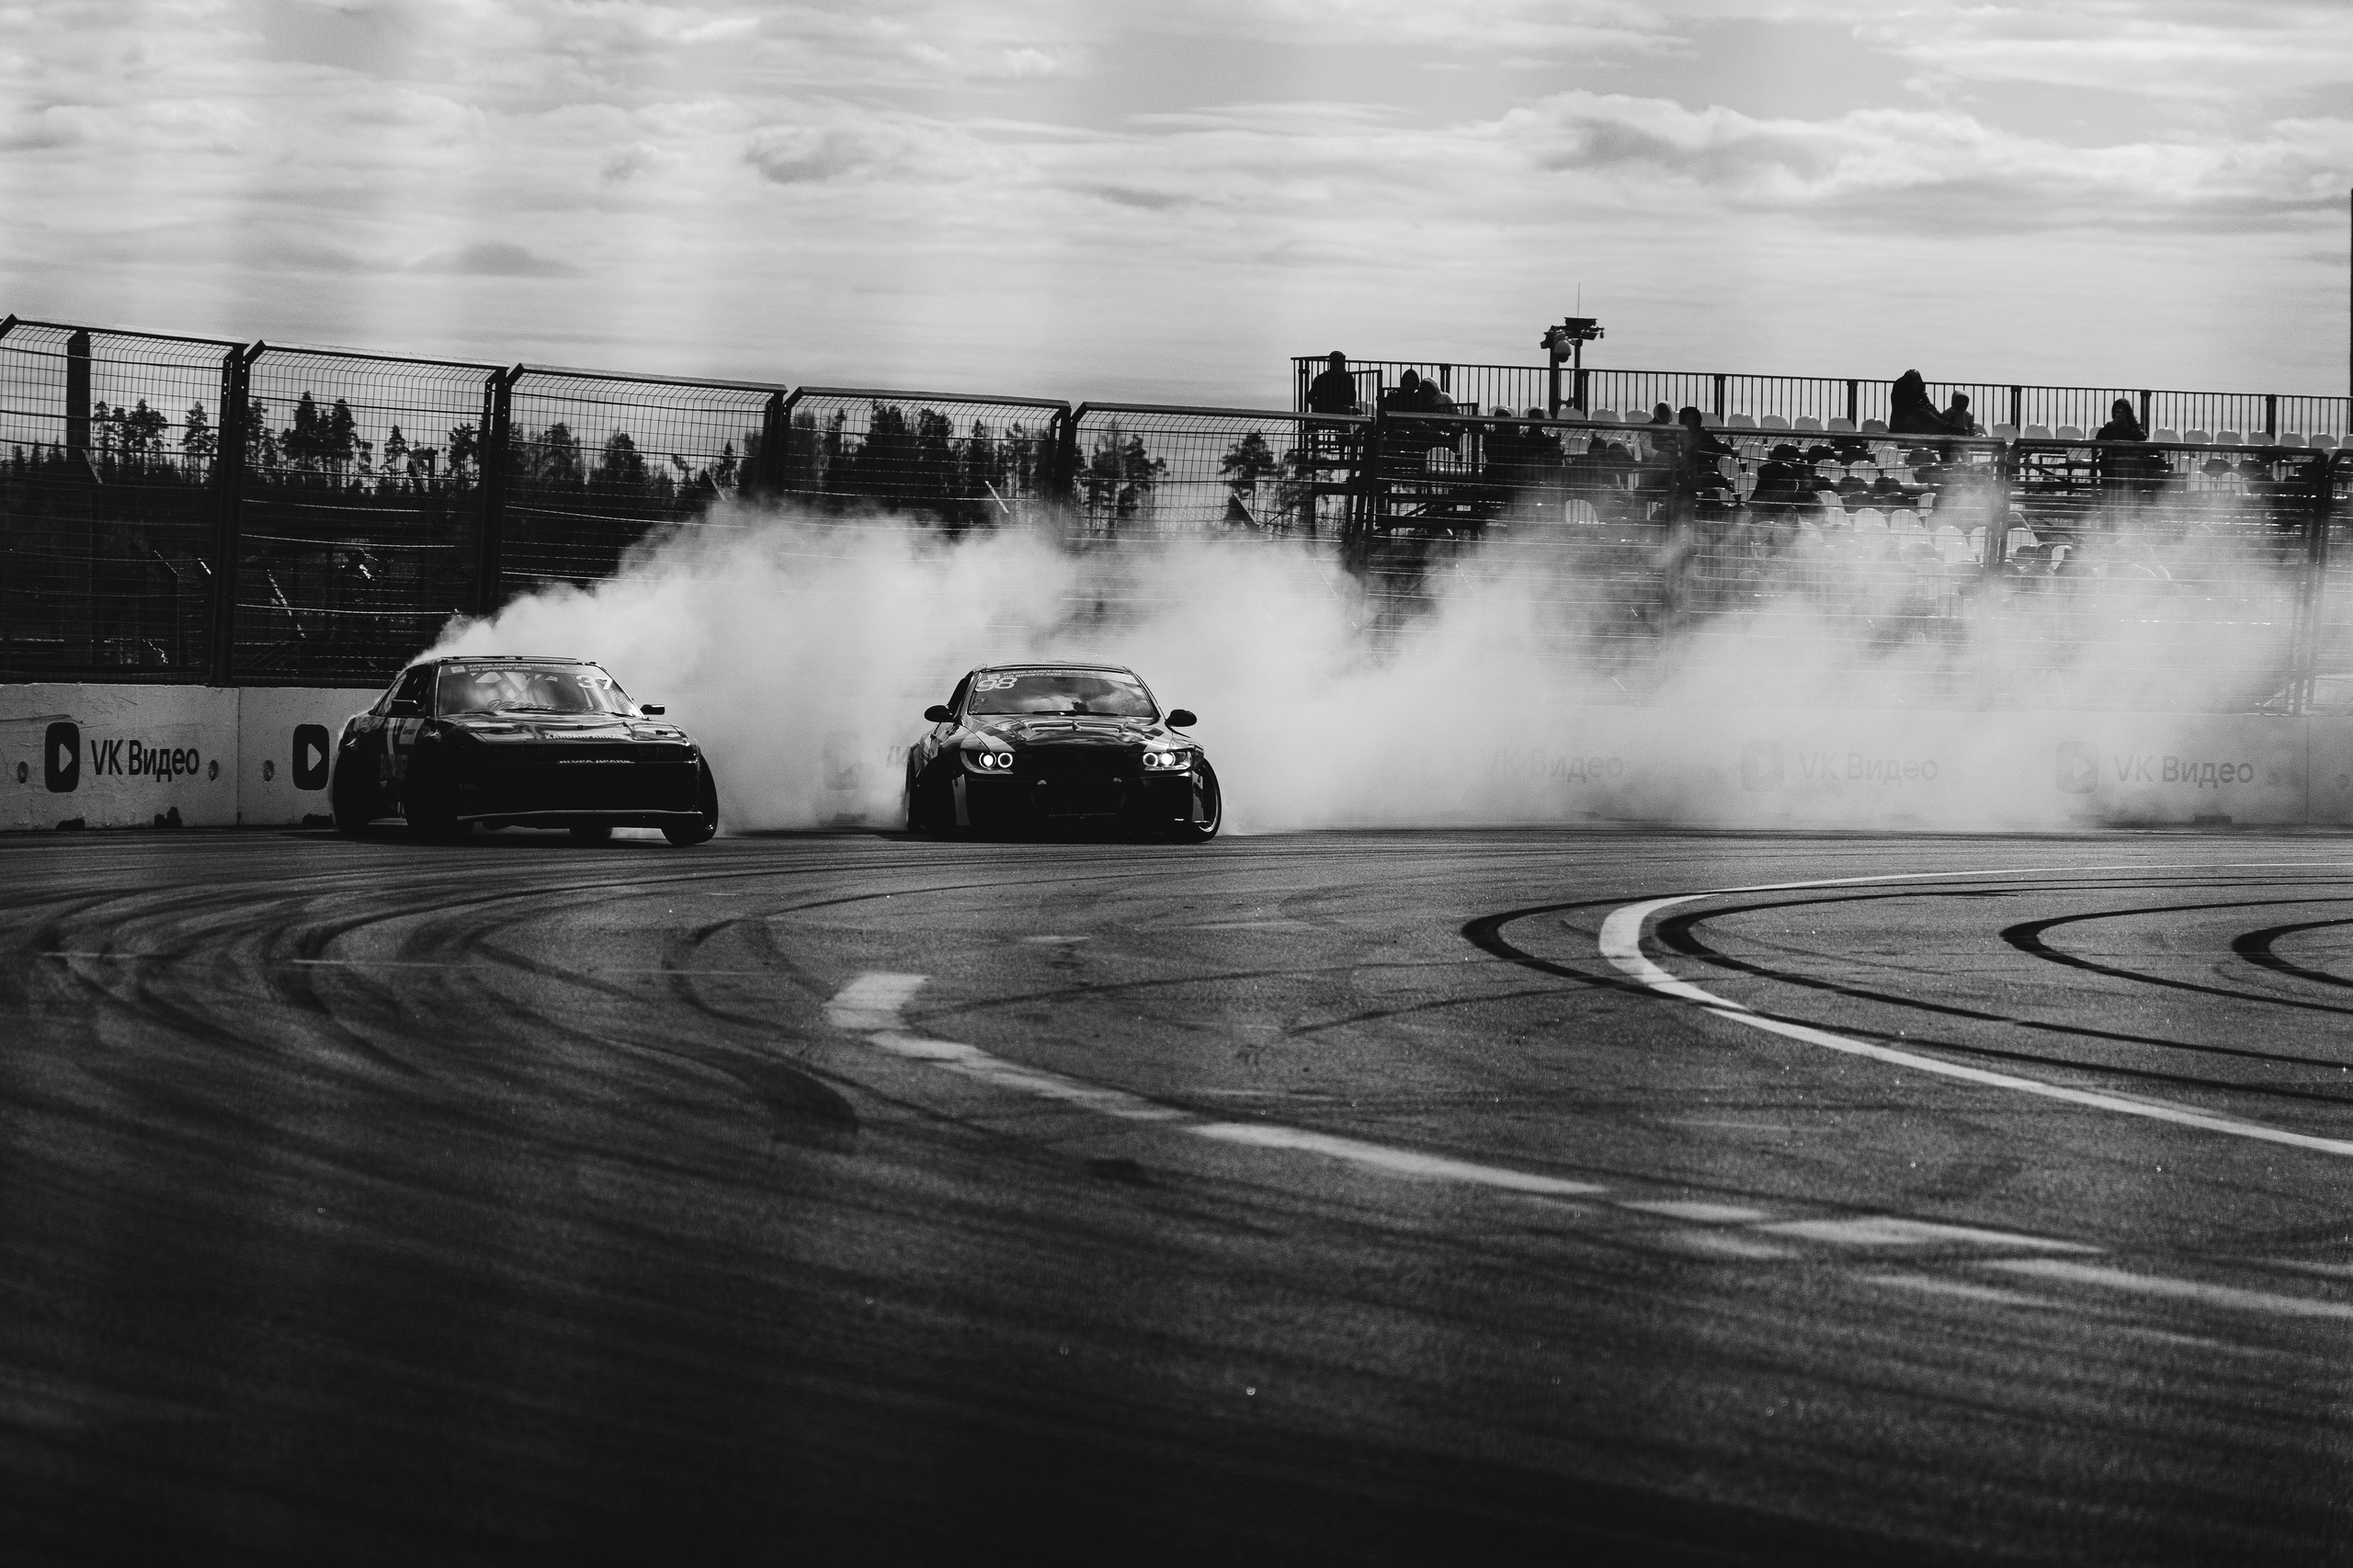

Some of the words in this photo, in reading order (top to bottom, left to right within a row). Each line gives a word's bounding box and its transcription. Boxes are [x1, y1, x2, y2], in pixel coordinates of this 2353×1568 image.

[575, 675, 613, 690] 37
[975, 676, 1017, 692] 98
[90, 739, 124, 775] VK
[129, 739, 200, 783] Видео
[1529, 748, 1624, 784] Видео
[1798, 751, 1838, 780] VK
[1847, 752, 1938, 786] Видео
[2112, 755, 2154, 782] VK
[2162, 756, 2255, 789] Видео
